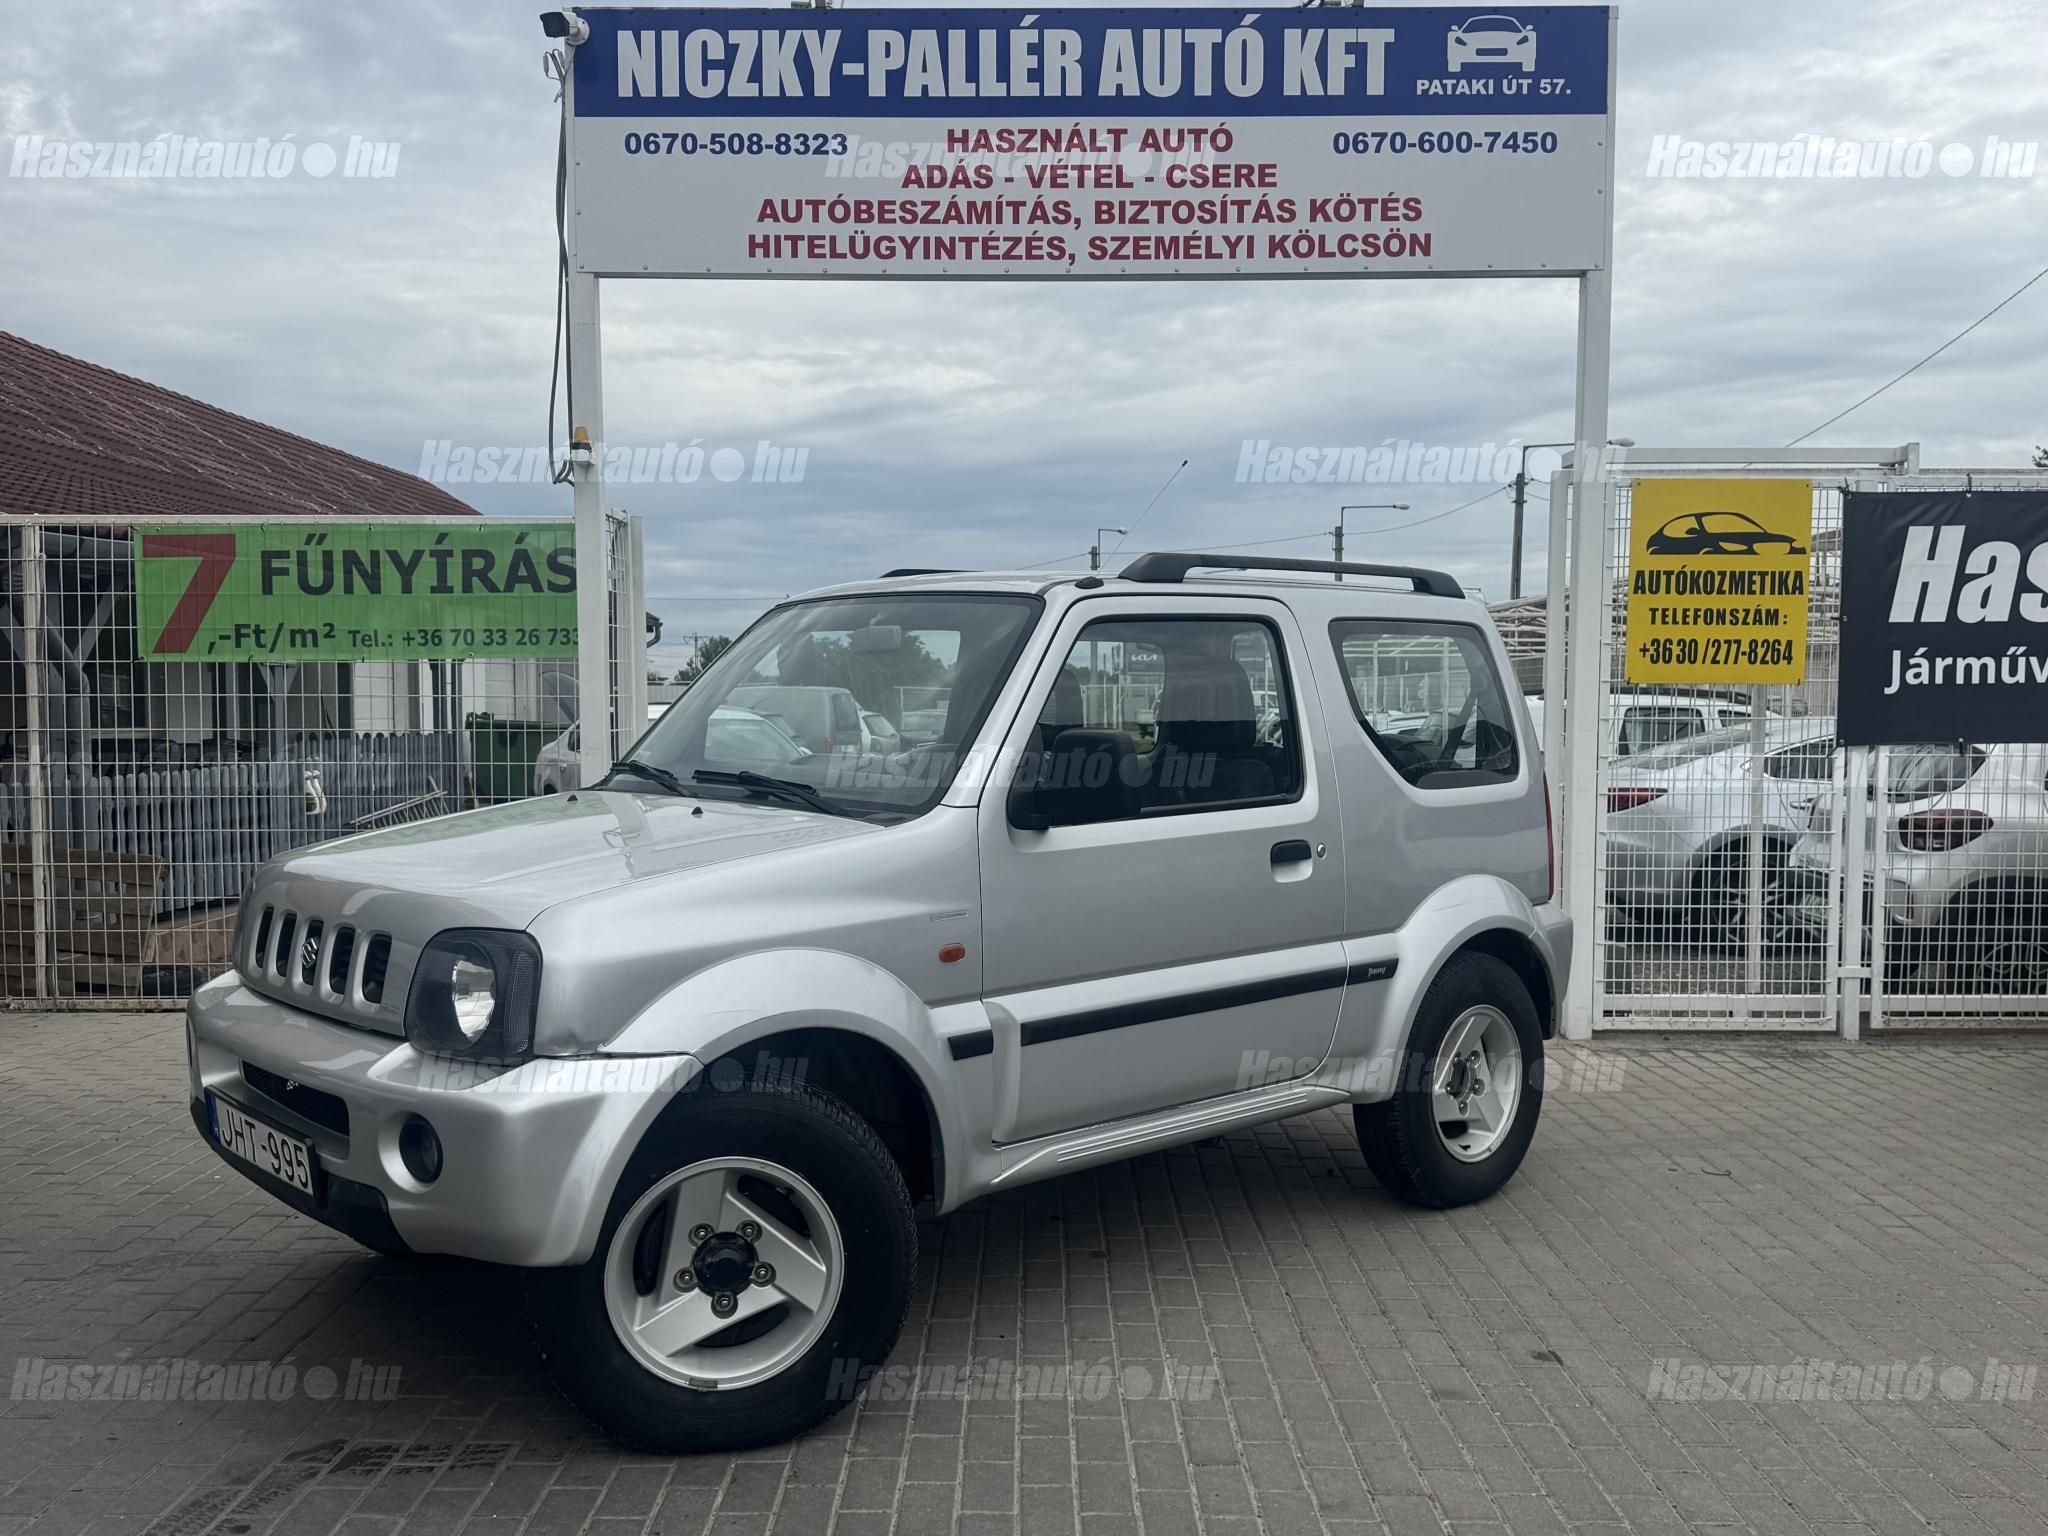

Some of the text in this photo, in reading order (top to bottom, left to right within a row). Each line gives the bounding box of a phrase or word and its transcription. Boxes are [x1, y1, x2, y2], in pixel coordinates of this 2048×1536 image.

[617, 14, 1395, 98] NICZKY-PALLÉR AUTÓ KFT
[1416, 75, 1571, 95] PATAKI ÚT 57.
[624, 132, 848, 156] 0670-508-8323
[947, 122, 1234, 153] HASZNÁLT AUTÓ
[1333, 131, 1558, 154] 0670-600-7450
[901, 158, 994, 189] ADÁS
[1024, 158, 1134, 188] VÉTEL
[1165, 163, 1278, 188] CSERE
[756, 191, 1423, 230] AUTÓBESZÁMÍTÁS, BIZTOSÍTÁS KÖTÉS
[748, 228, 1432, 266] HITELÜGYINTÉZÉS, SZEMÉLYI KÖLCSÖN
[260, 532, 577, 595] FŰNYÍRÁS
[1632, 565, 1805, 596] AUTÓKOZMETIKA
[1888, 524, 2048, 624] Has
[347, 630, 393, 648] Tel.:
[402, 630, 443, 647] +36
[451, 629, 475, 647] 70
[482, 629, 507, 646] 33
[515, 629, 540, 646] 26
[1884, 646, 2048, 694] Járműv
[222, 1109, 308, 1188] JHT-995
